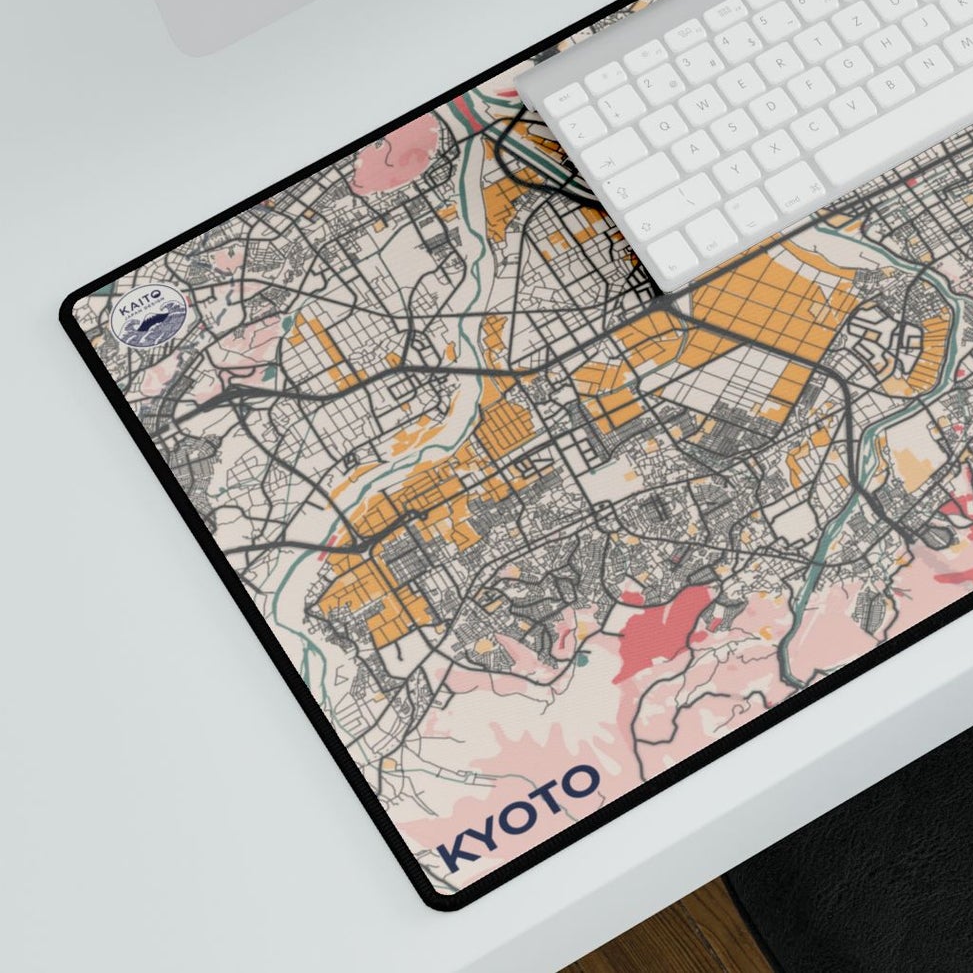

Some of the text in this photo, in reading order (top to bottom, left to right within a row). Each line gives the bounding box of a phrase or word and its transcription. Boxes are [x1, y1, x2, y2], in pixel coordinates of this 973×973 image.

[659, 121, 671, 132] Q
[695, 99, 710, 112] W
[736, 79, 747, 90] E
[775, 58, 786, 68] R
[814, 37, 824, 47] T
[852, 16, 863, 27] Z
[689, 143, 700, 154] A
[727, 122, 737, 133] S
[766, 101, 776, 111] D
[805, 79, 814, 90] F
[843, 59, 854, 69] G
[880, 38, 892, 49] H
[921, 17, 928, 28] J
[730, 37, 973, 174] Y X C V B N M
[119, 289, 161, 316] KAITO
[436, 764, 601, 874] KYOTO
